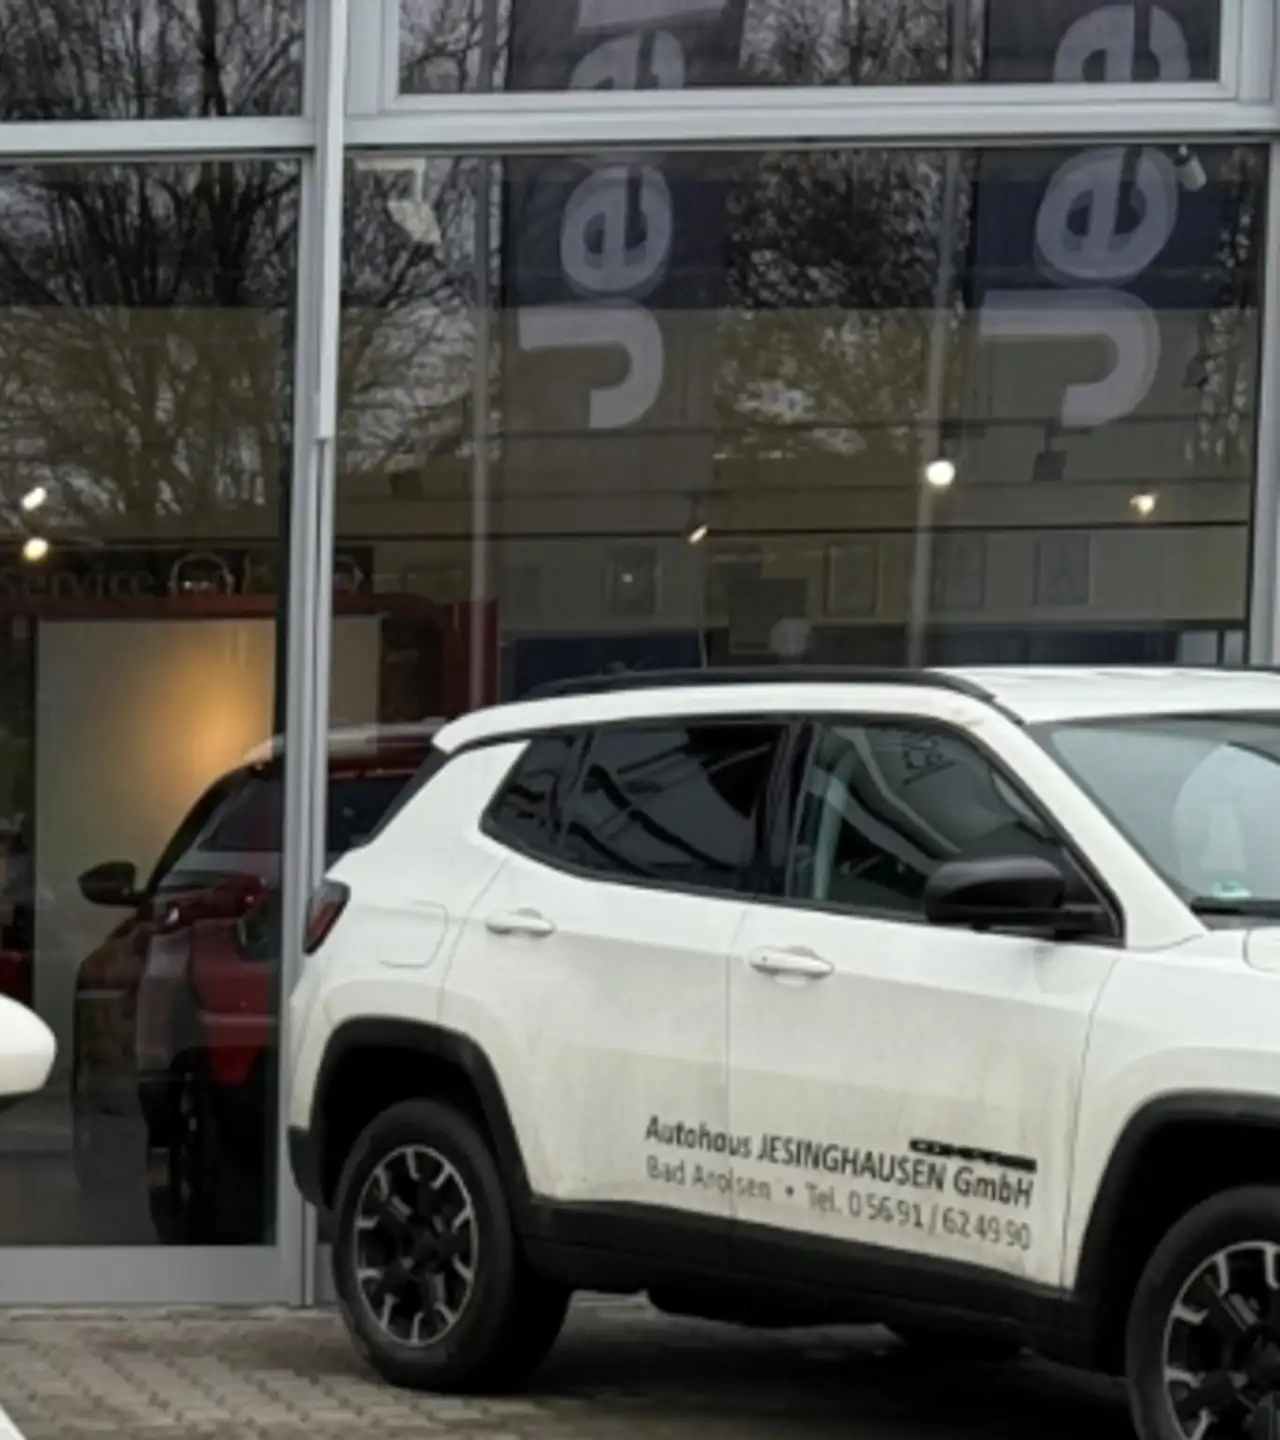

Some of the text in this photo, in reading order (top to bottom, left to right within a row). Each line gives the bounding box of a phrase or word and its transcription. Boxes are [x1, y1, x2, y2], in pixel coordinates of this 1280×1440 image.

[645, 1114, 752, 1159] Autohaus
[756, 1133, 947, 1193] JESINGHAUSEN
[953, 1165, 1034, 1209] GmbH
[646, 1154, 685, 1185] Bad
[691, 1163, 771, 1201] Arolsen
[804, 1181, 843, 1213] Tel.
